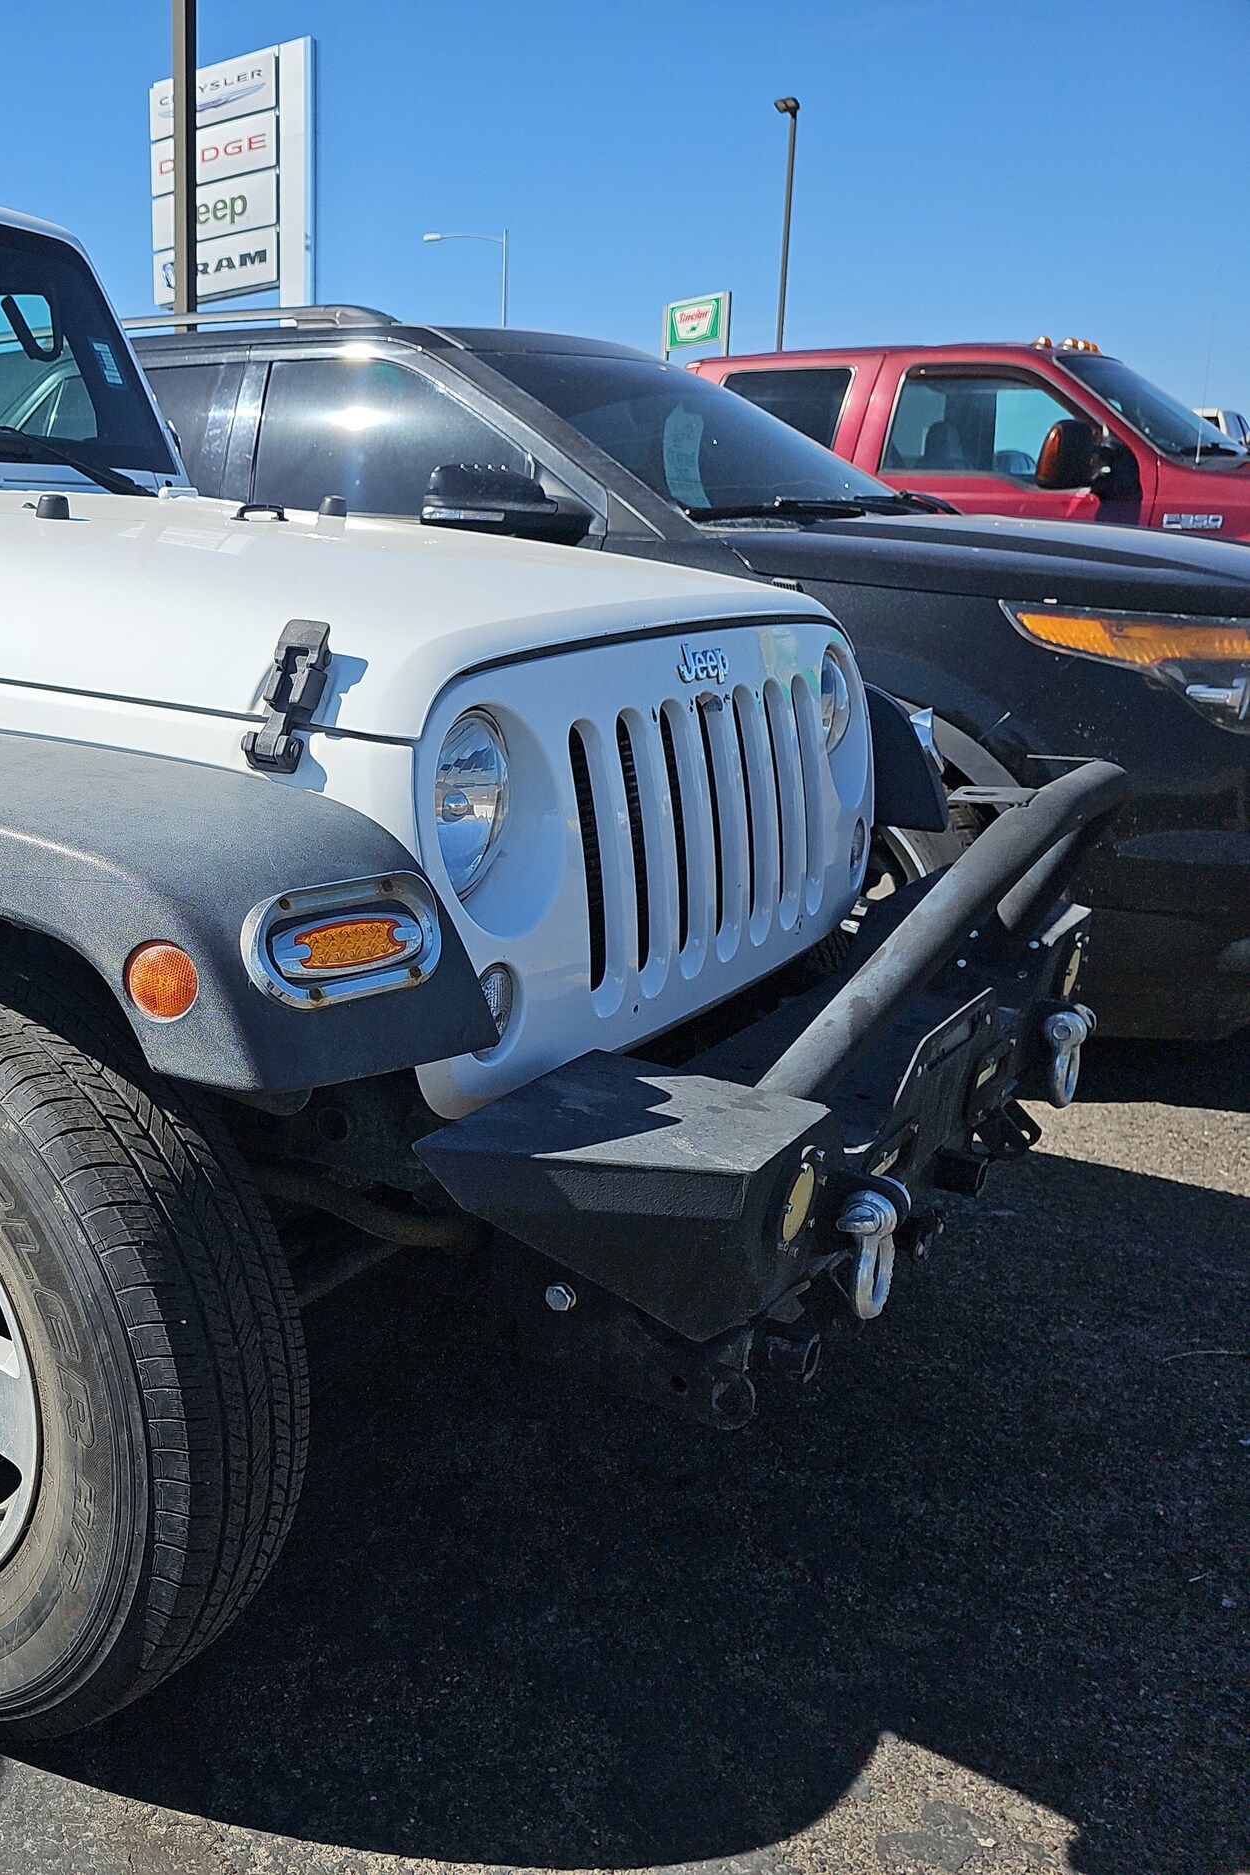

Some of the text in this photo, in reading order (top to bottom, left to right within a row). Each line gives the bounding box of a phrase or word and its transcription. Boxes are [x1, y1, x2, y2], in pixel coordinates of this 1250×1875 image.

[159, 69, 263, 107] CYSLER
[159, 133, 267, 175] DDGE
[197, 193, 248, 225] eep
[677, 642, 729, 685] Jeep
